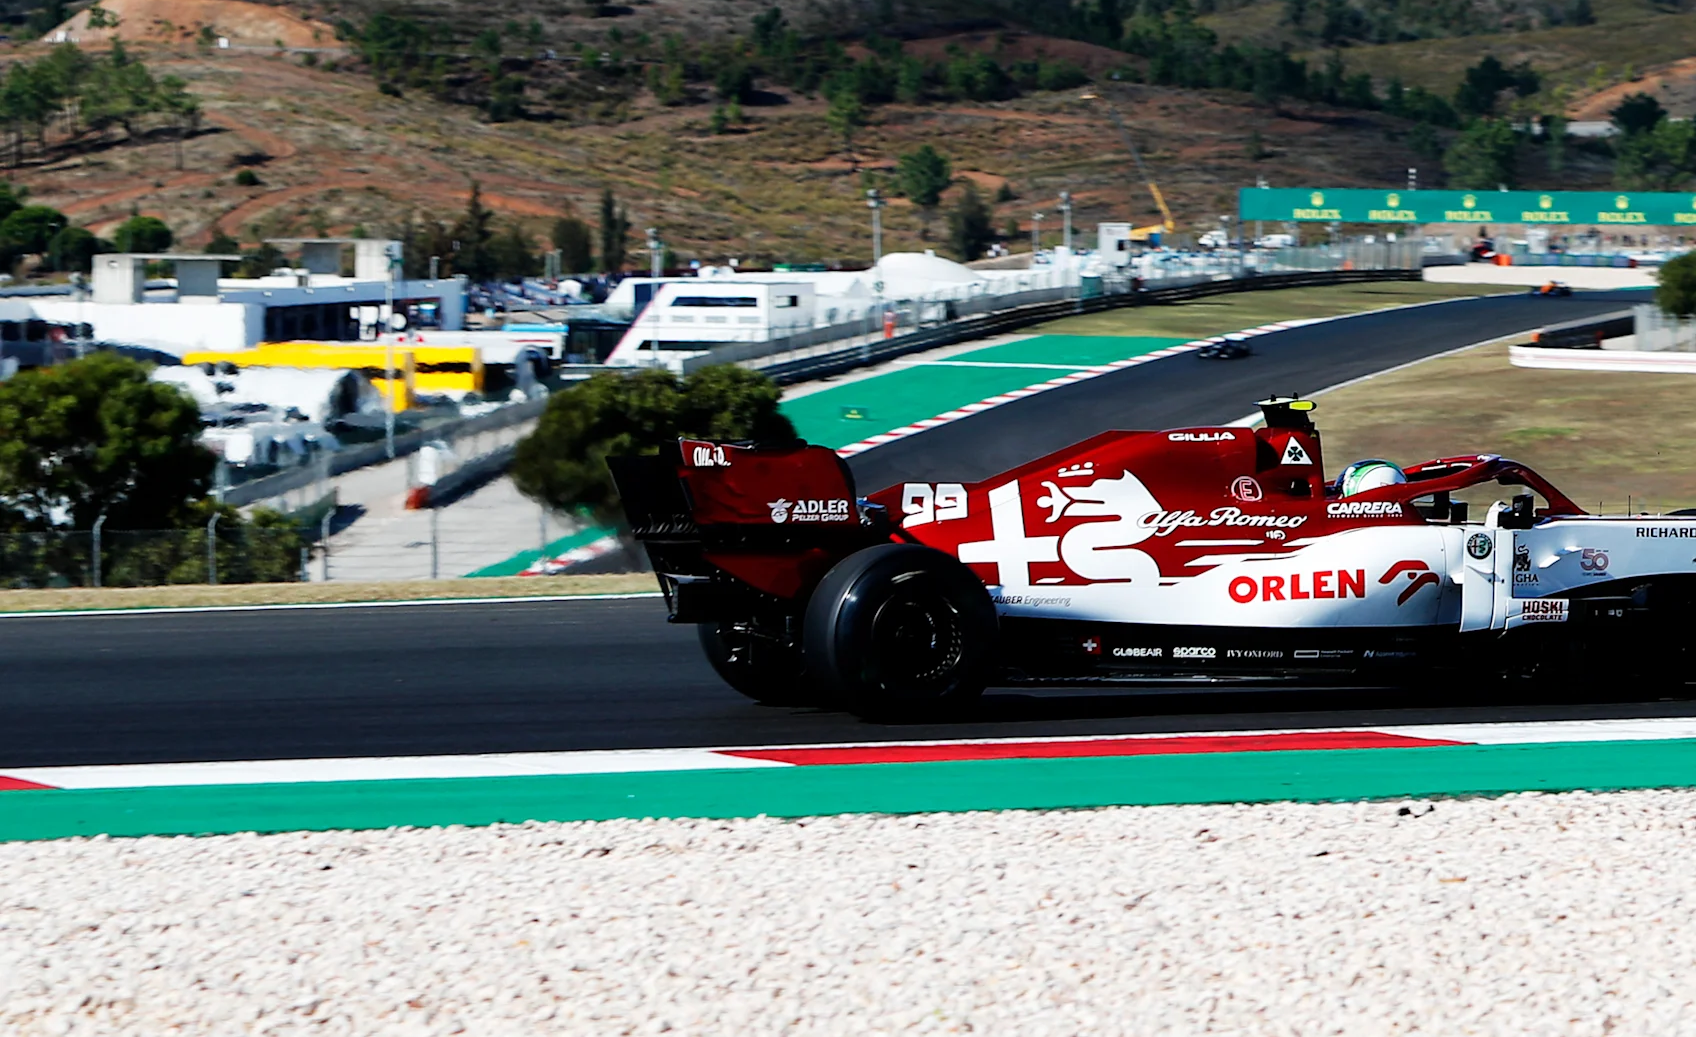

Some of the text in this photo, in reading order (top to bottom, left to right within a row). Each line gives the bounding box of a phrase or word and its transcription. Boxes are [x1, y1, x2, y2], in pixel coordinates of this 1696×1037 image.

[1168, 432, 1236, 442] GIULIA
[791, 499, 849, 514] ADLER
[901, 483, 968, 529] 99
[1326, 502, 1403, 514] CARRERA
[1136, 506, 1308, 537] Alfa Romeo
[1580, 548, 1610, 571] 50
[1515, 573, 1539, 583] GHA
[1228, 569, 1365, 604] ORLEN
[1113, 647, 1163, 657] GLOBEAIR
[1172, 646, 1217, 658] sparco
